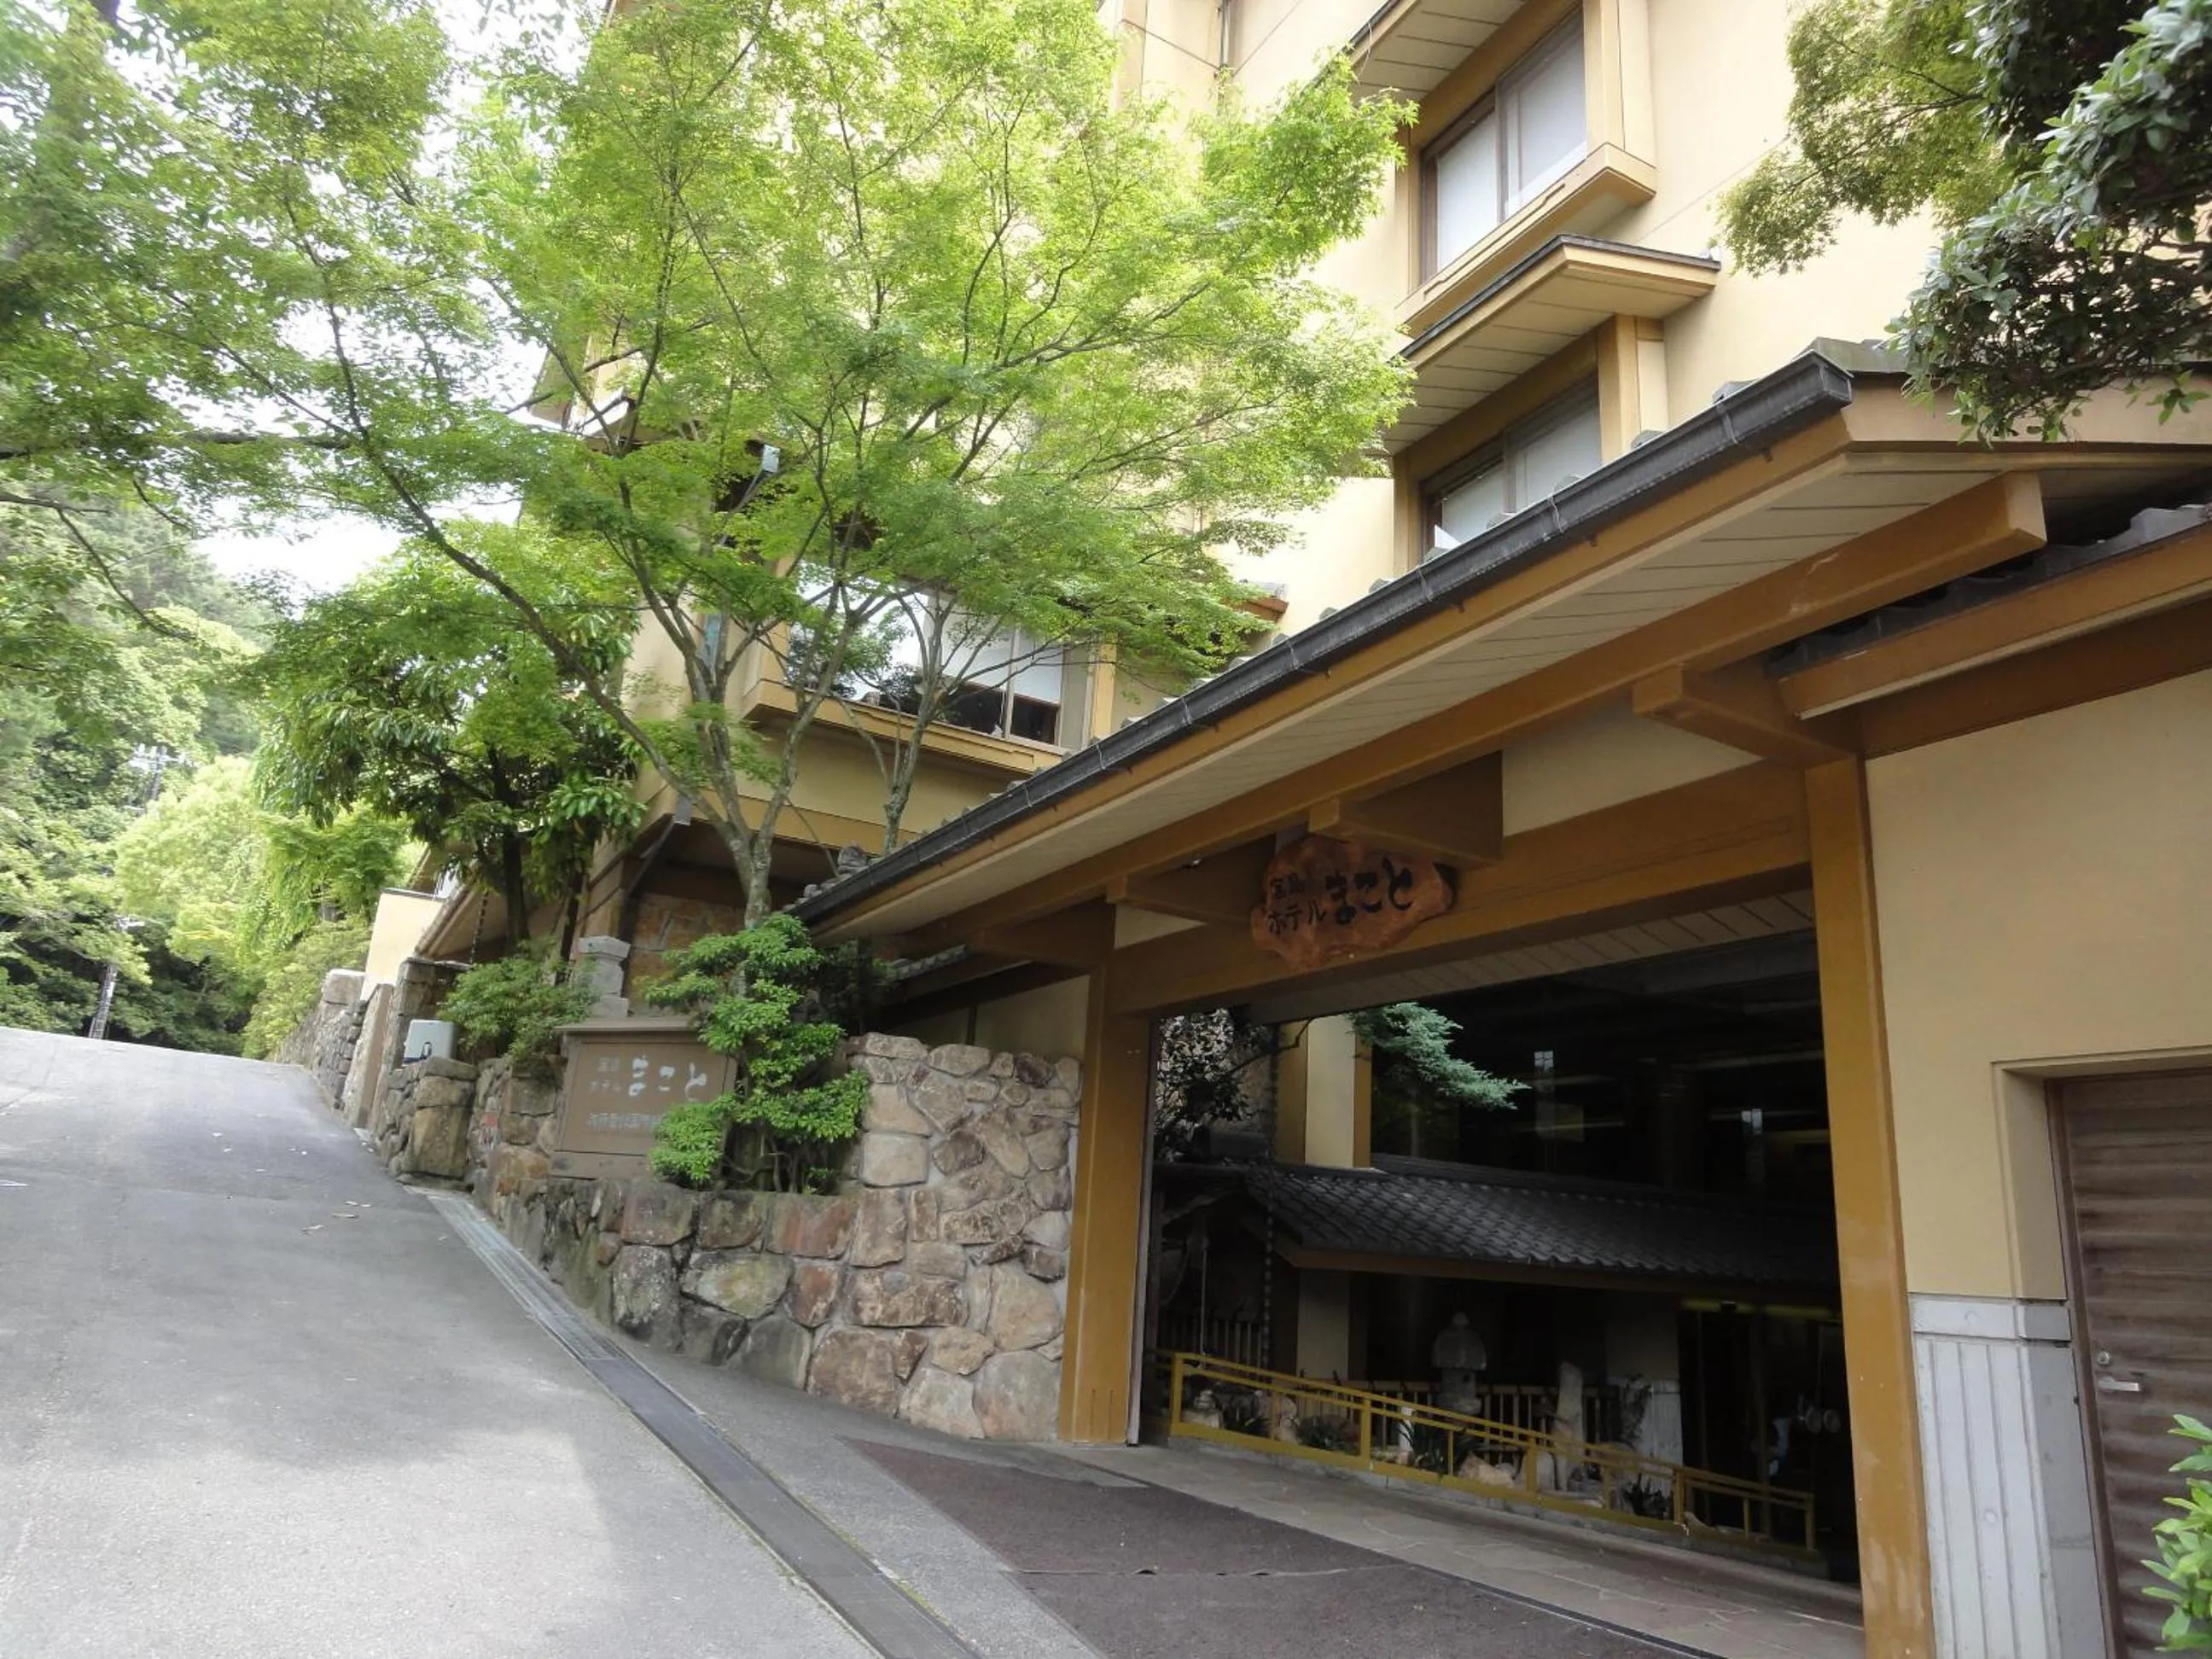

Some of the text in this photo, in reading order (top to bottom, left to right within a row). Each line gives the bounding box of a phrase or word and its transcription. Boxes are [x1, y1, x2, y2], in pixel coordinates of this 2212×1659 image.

[1267, 899, 1327, 935] ホテル
[1325, 856, 1414, 925] まこと
[627, 1050, 707, 1103] まこと
